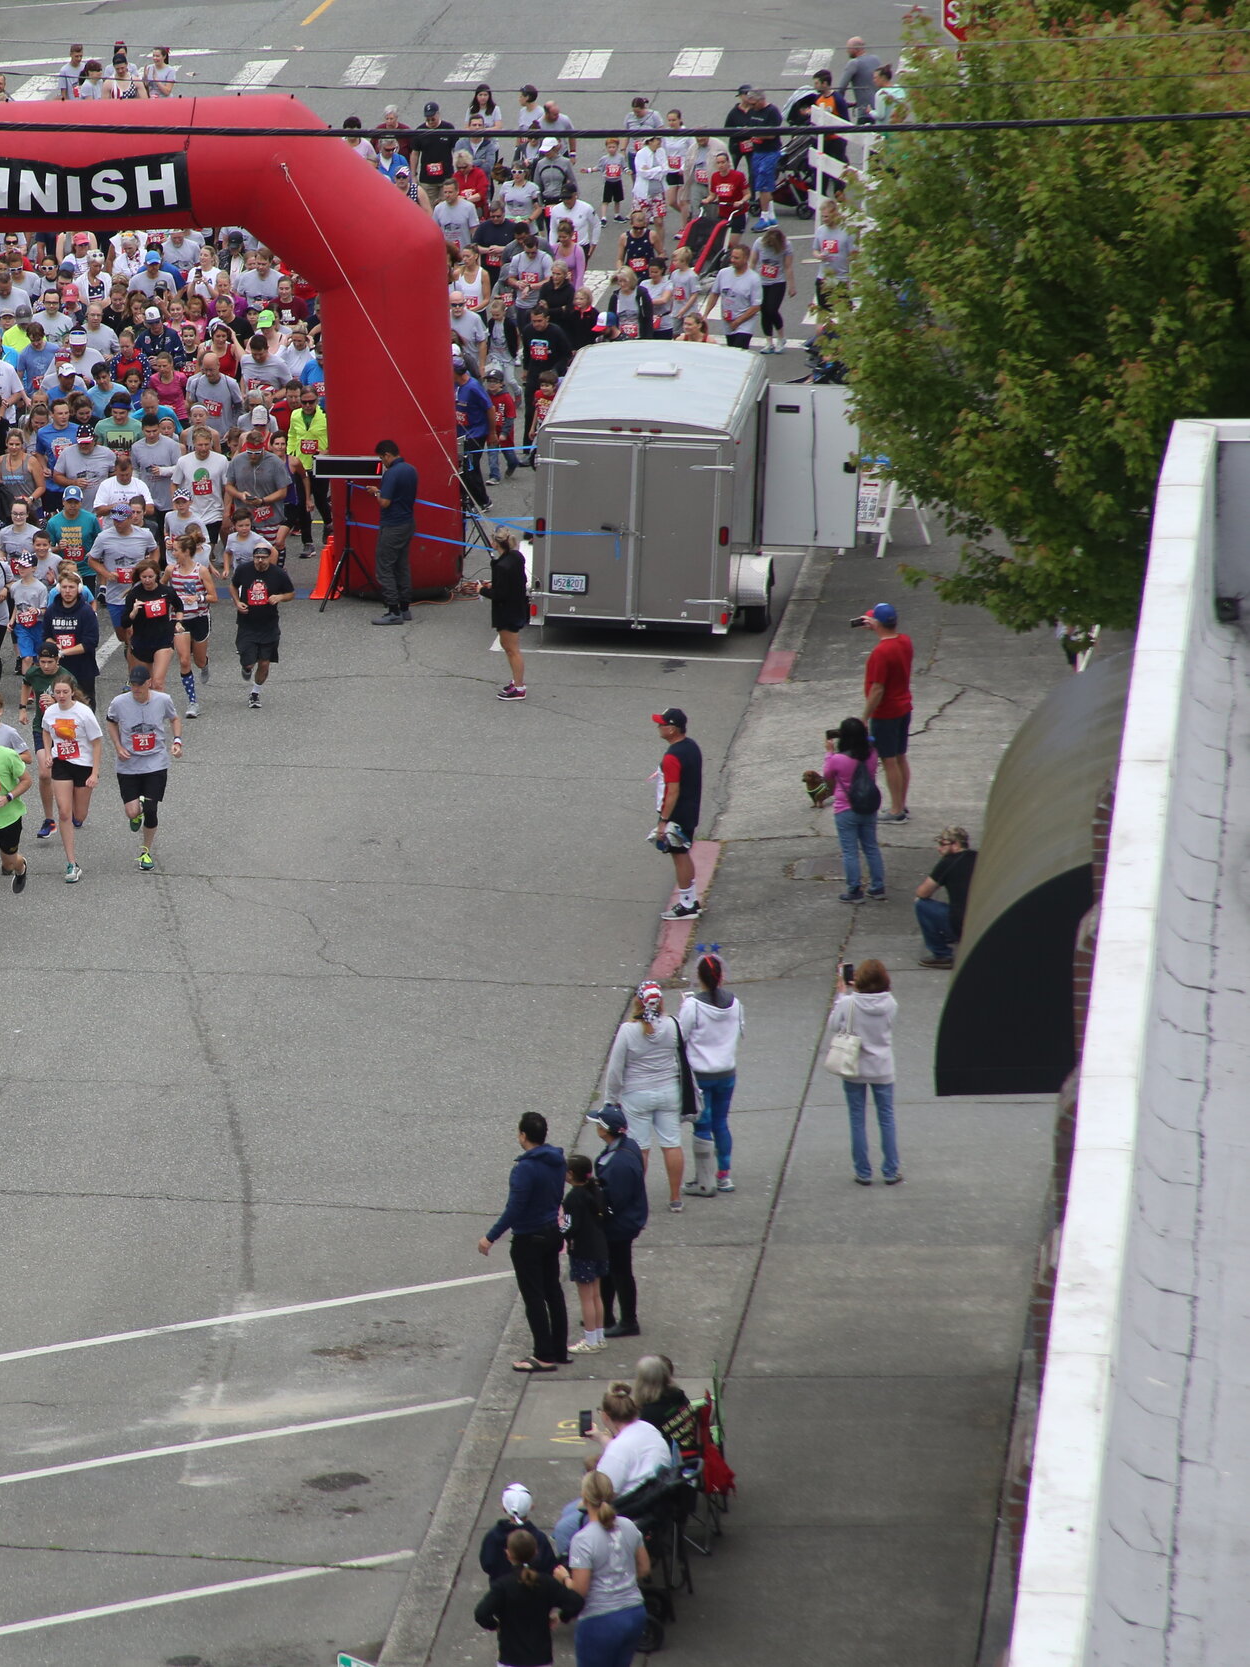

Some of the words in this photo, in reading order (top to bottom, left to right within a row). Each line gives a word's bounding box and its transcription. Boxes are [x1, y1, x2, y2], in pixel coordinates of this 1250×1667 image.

[66, 550, 82, 558] 359
[150, 604, 161, 612] 65
[139, 738, 150, 746] 21
